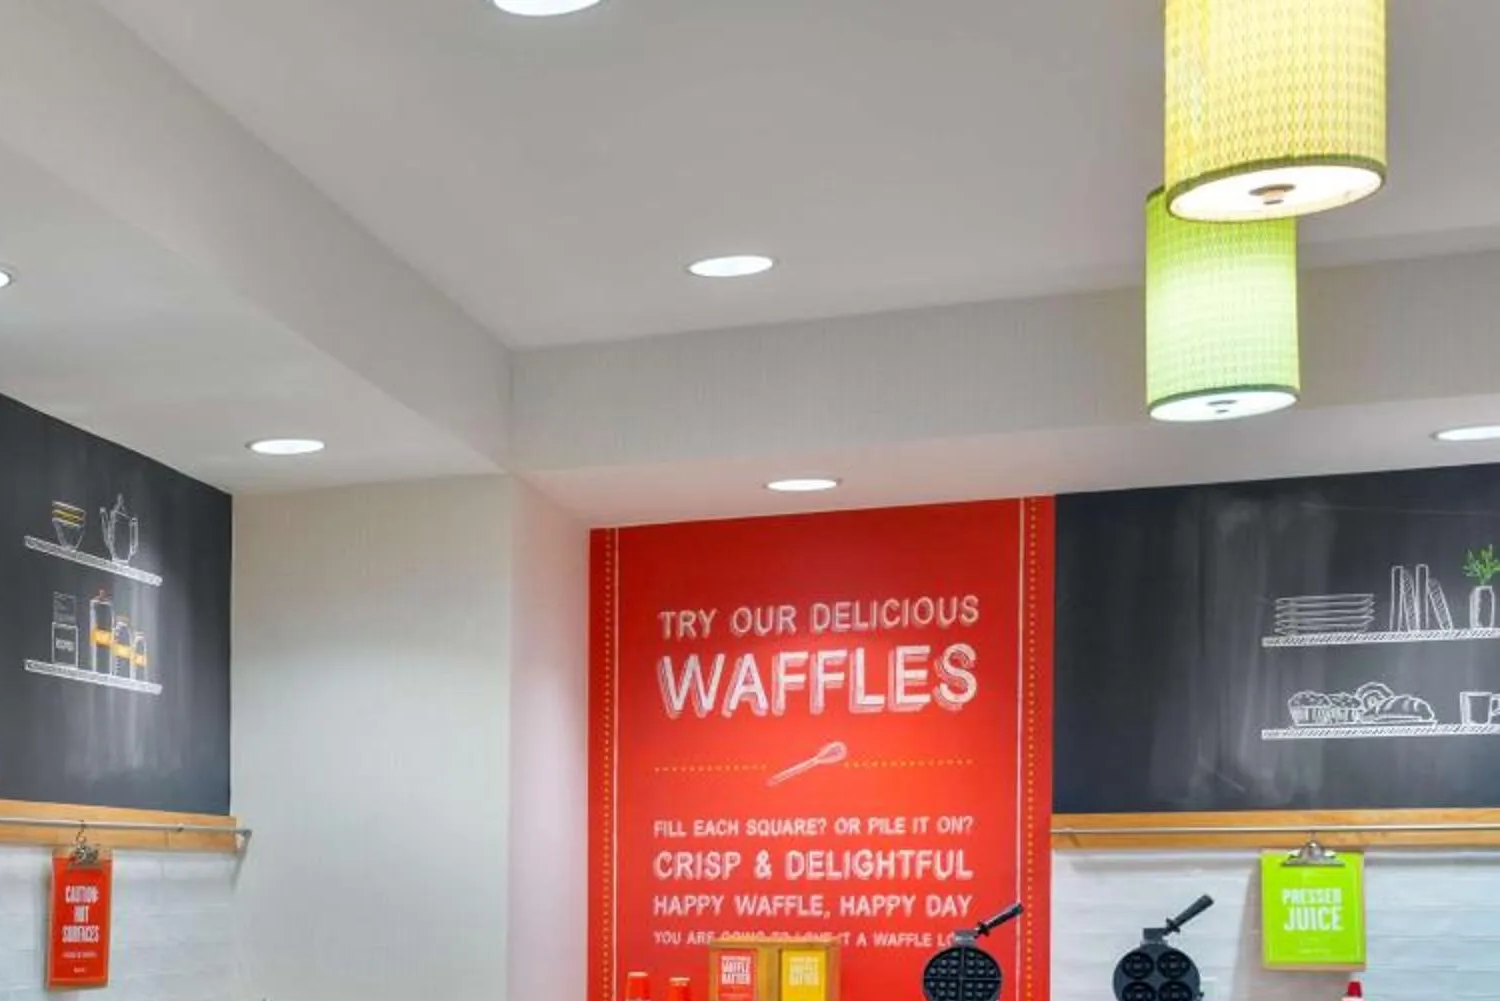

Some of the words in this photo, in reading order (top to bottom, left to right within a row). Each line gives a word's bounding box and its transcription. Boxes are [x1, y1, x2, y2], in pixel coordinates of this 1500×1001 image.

[658, 608, 717, 639] TRY
[730, 604, 797, 636] OUR
[809, 594, 980, 632] DELICIOUS
[656, 643, 979, 718] WAFFLES
[653, 819, 687, 838] FILL
[693, 818, 739, 838] EACH
[745, 817, 828, 837] SQUARE?
[834, 816, 861, 836] OR
[867, 815, 906, 835] PILE
[912, 815, 930, 834] IT
[936, 815, 974, 835] ON?
[653, 851, 742, 881] CRISP
[753, 849, 773, 880] &
[784, 848, 974, 881] DELIGHTFUL
[653, 895, 725, 917] HAPPY
[733, 894, 831, 919] WAFFLE,
[839, 895, 917, 917] HAPPY
[925, 894, 973, 917] DAY
[1283, 906, 1344, 932] JUICE
[653, 931, 682, 945] YOU
[687, 931, 715, 945] ARE
[856, 933, 867, 948] A
[873, 932, 933, 947] WAFFLE
